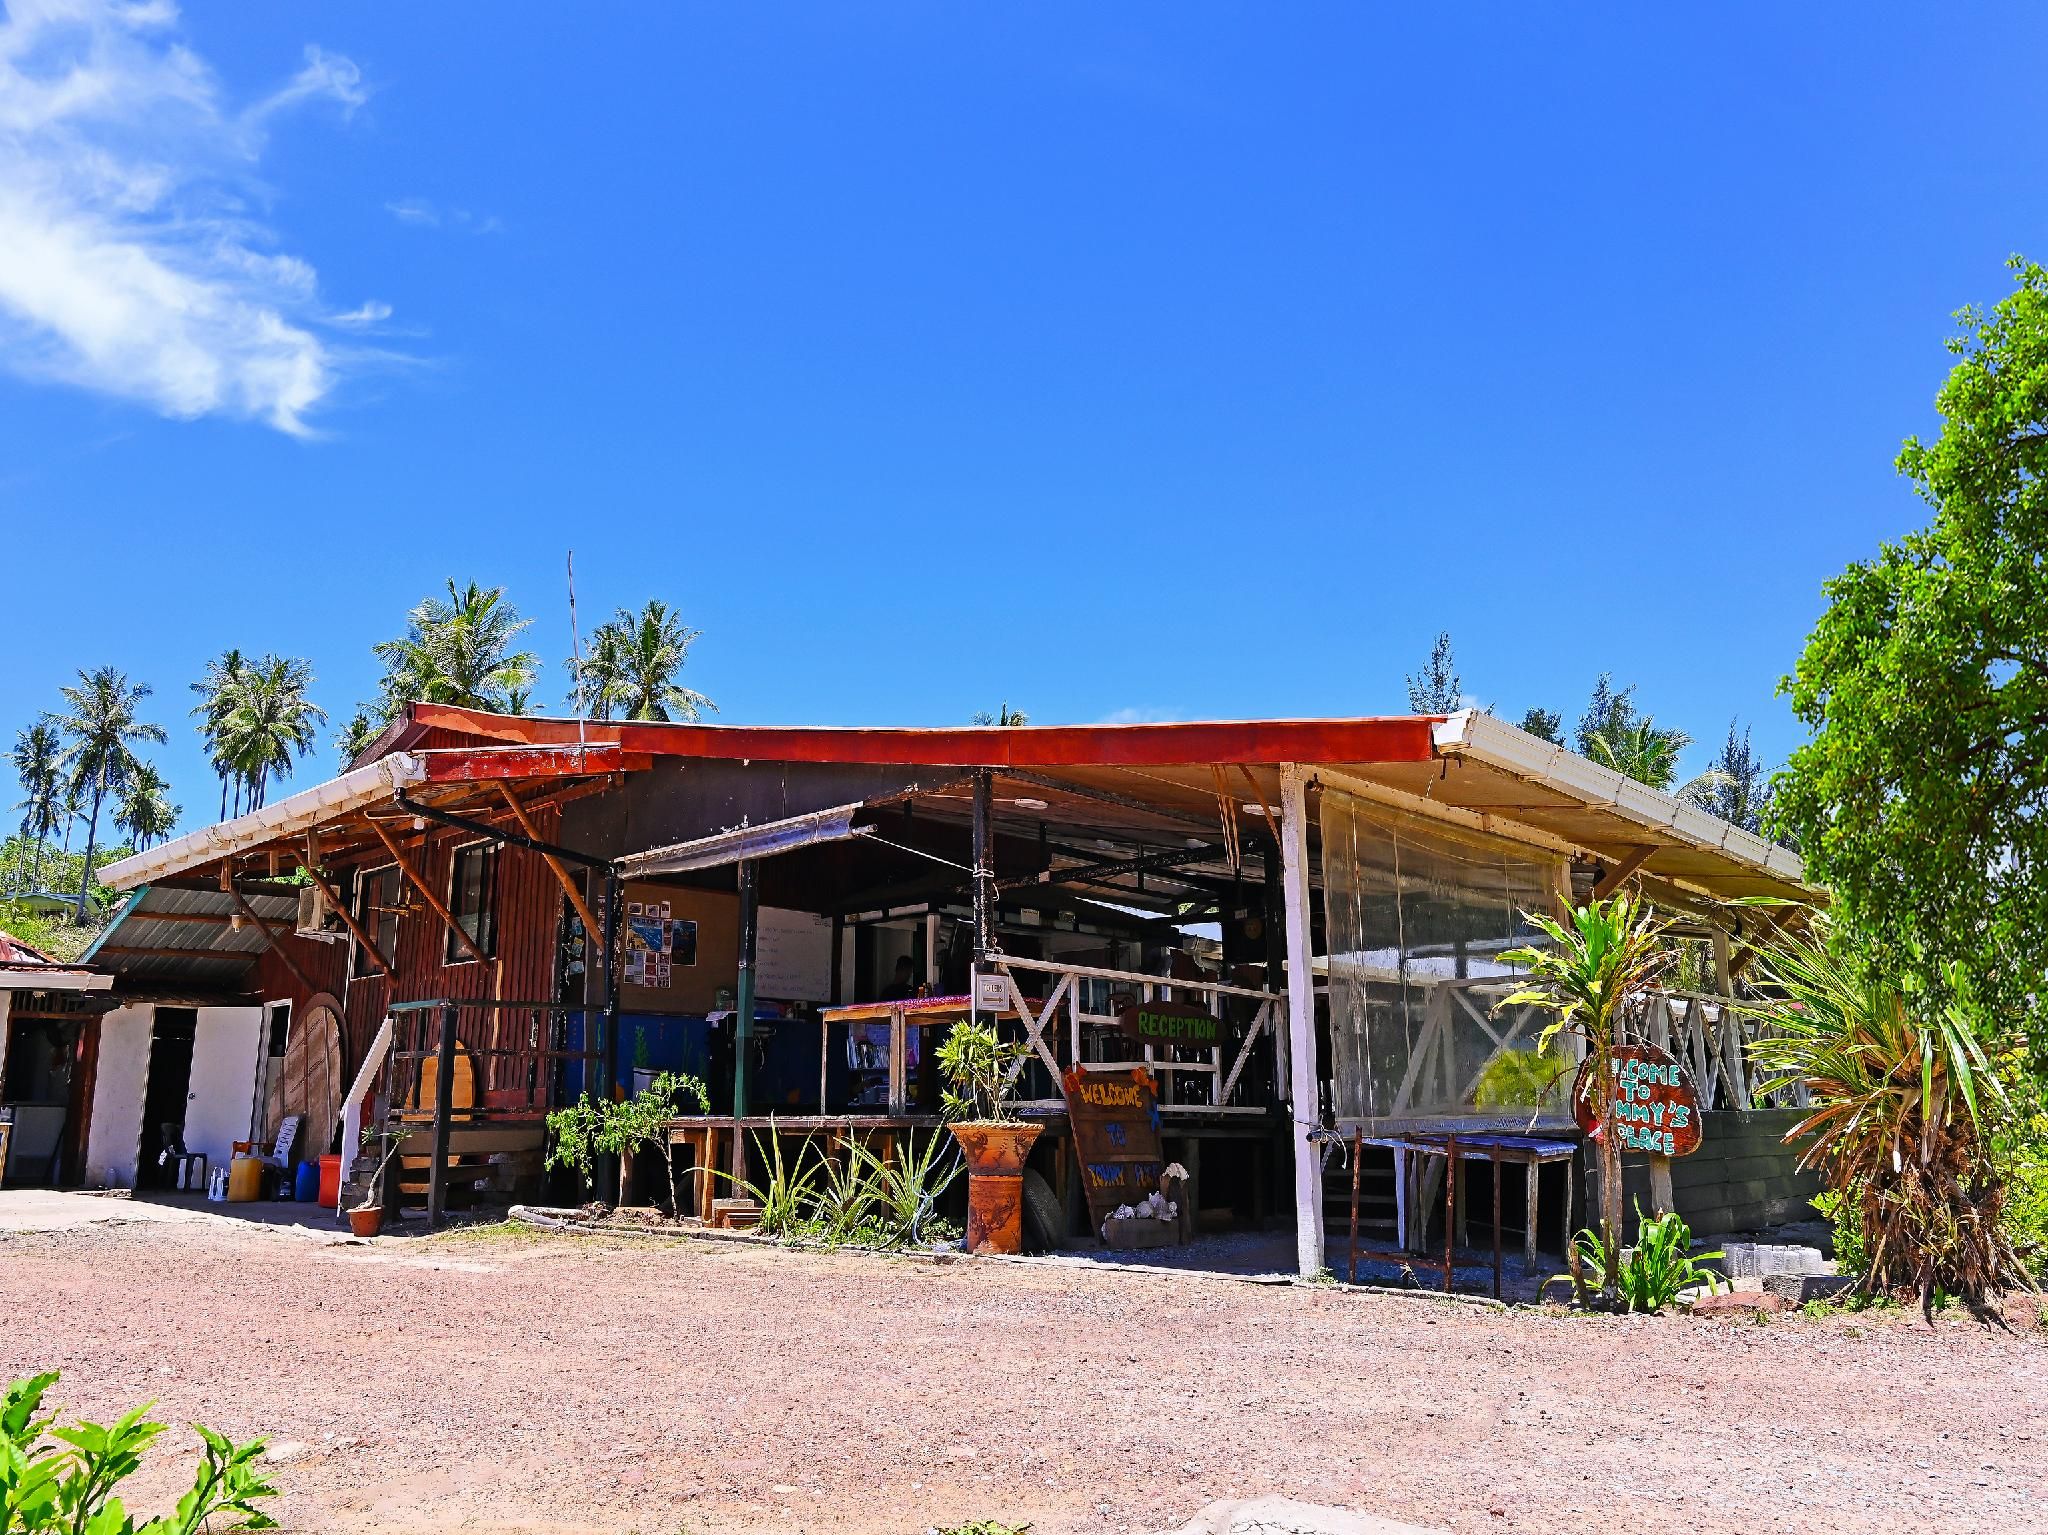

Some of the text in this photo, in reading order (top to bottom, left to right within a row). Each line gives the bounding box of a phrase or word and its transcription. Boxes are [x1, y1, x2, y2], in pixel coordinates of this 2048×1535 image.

[1138, 1011, 1217, 1040] RECEPTION
[1079, 1082, 1143, 1108] WELCOME
[1620, 1080, 1651, 1102] TO
[1105, 1123, 1127, 1146] TO
[1617, 1122, 1675, 1156] PLACE
